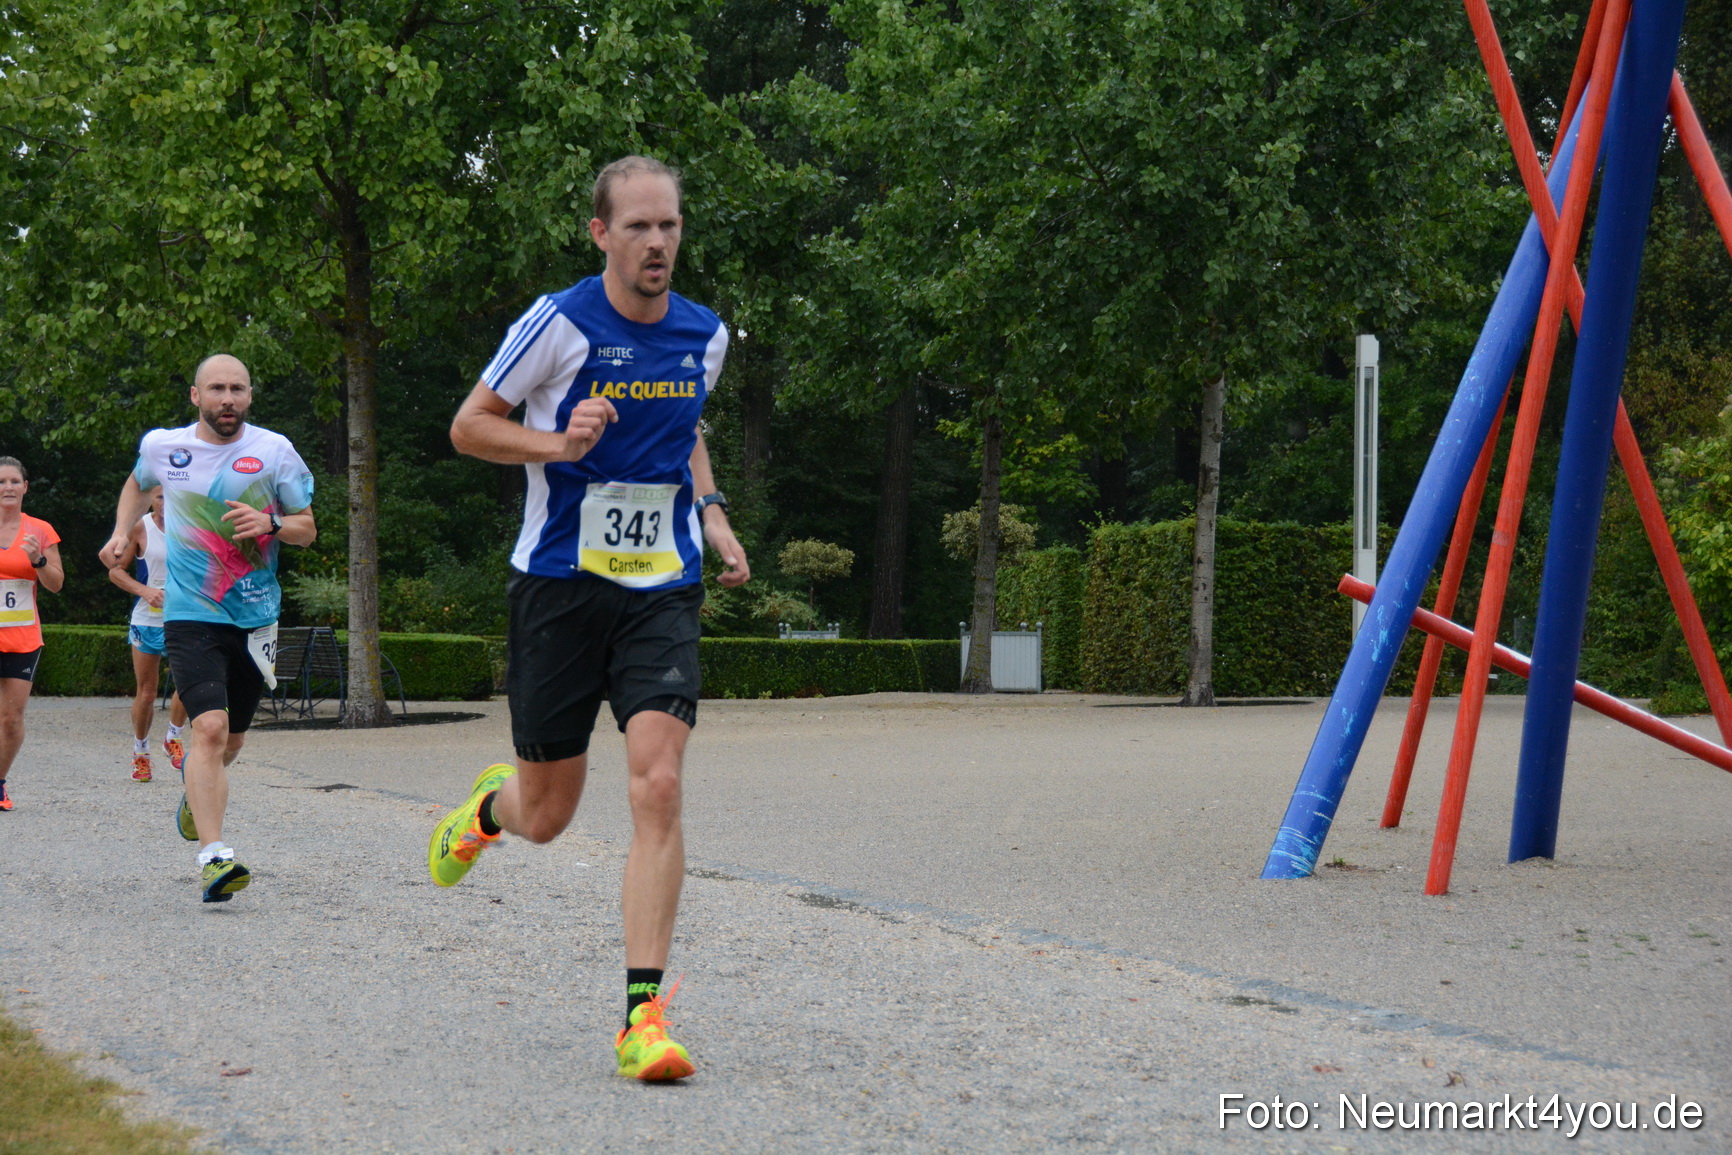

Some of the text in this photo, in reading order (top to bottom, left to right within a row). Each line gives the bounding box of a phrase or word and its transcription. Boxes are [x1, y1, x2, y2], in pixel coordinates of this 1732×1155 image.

[597, 347, 634, 359] HEITEC
[590, 381, 697, 401] LAC QUELLE
[167, 470, 190, 478] PARTL
[604, 508, 661, 547] 343
[609, 557, 654, 573] Carsten
[240, 578, 255, 590] 17.
[5, 591, 16, 608] 6
[262, 640, 277, 663] 32
